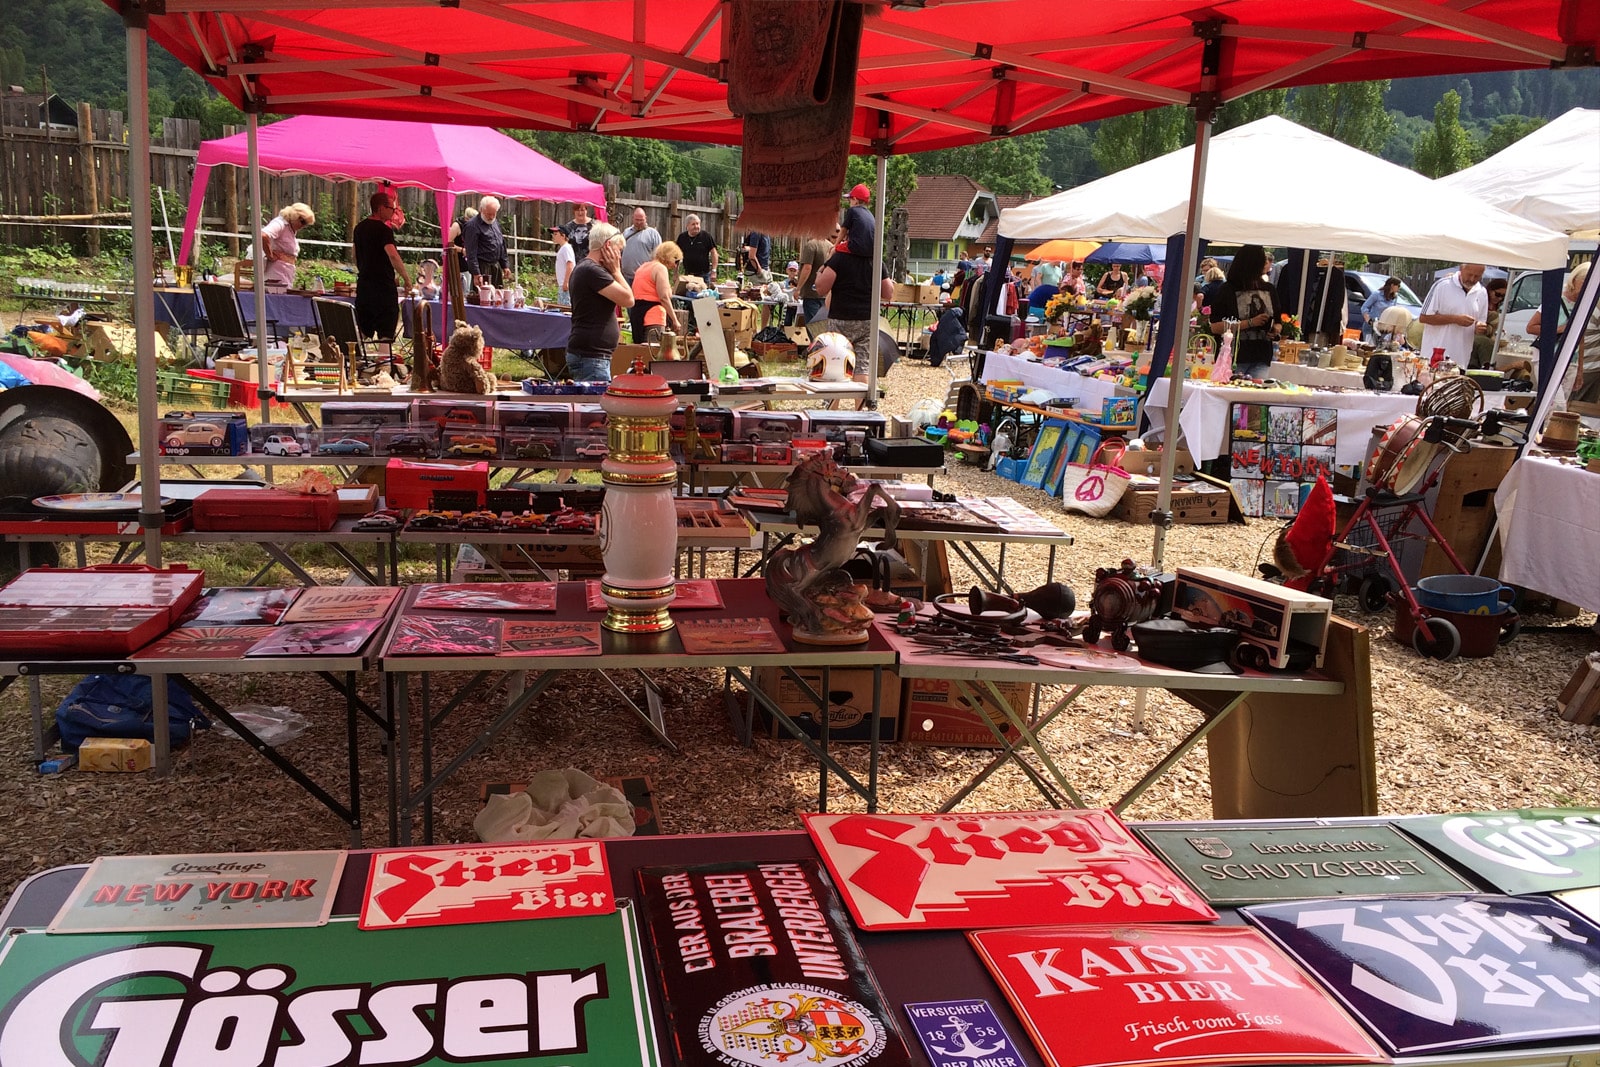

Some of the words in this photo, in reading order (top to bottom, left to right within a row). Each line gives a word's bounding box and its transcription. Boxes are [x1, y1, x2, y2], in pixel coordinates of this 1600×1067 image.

[1232, 449, 1275, 475] NEW
[1279, 453, 1332, 478] YORK
[913, 678, 950, 692] Dole
[911, 731, 963, 742] PREMIUM
[967, 734, 1019, 743] BANAAS
[169, 860, 266, 876] Greetings
[829, 813, 1127, 918] Stiegl
[1201, 858, 1427, 881] SCHUTZGEBIET
[93, 883, 193, 903] NEW
[207, 879, 317, 901] YORK
[373, 846, 595, 922] Stiegl
[662, 872, 694, 899] DER
[1063, 873, 1192, 909] Bier
[513, 889, 607, 911] Bier
[671, 897, 703, 931] AUS
[758, 863, 849, 981] UNTERBERGEN
[1008, 944, 1303, 998] KAISER
[1297, 901, 1588, 1026] Zipfer
[0, 942, 607, 1067] Gösser
[1125, 980, 1245, 1004] BIER
[698, 1015, 716, 1054] BRAUEREI
[770, 982, 843, 999] KLAGENFURT
[912, 1003, 987, 1019] VERSICHERT
[925, 1029, 946, 1042] 18
[976, 1026, 998, 1037] 58
[1124, 1019, 1187, 1042] Frisch
[1191, 1014, 1236, 1029] vom
[1238, 1011, 1283, 1028] Fass
[973, 1056, 1017, 1067] ANKER
